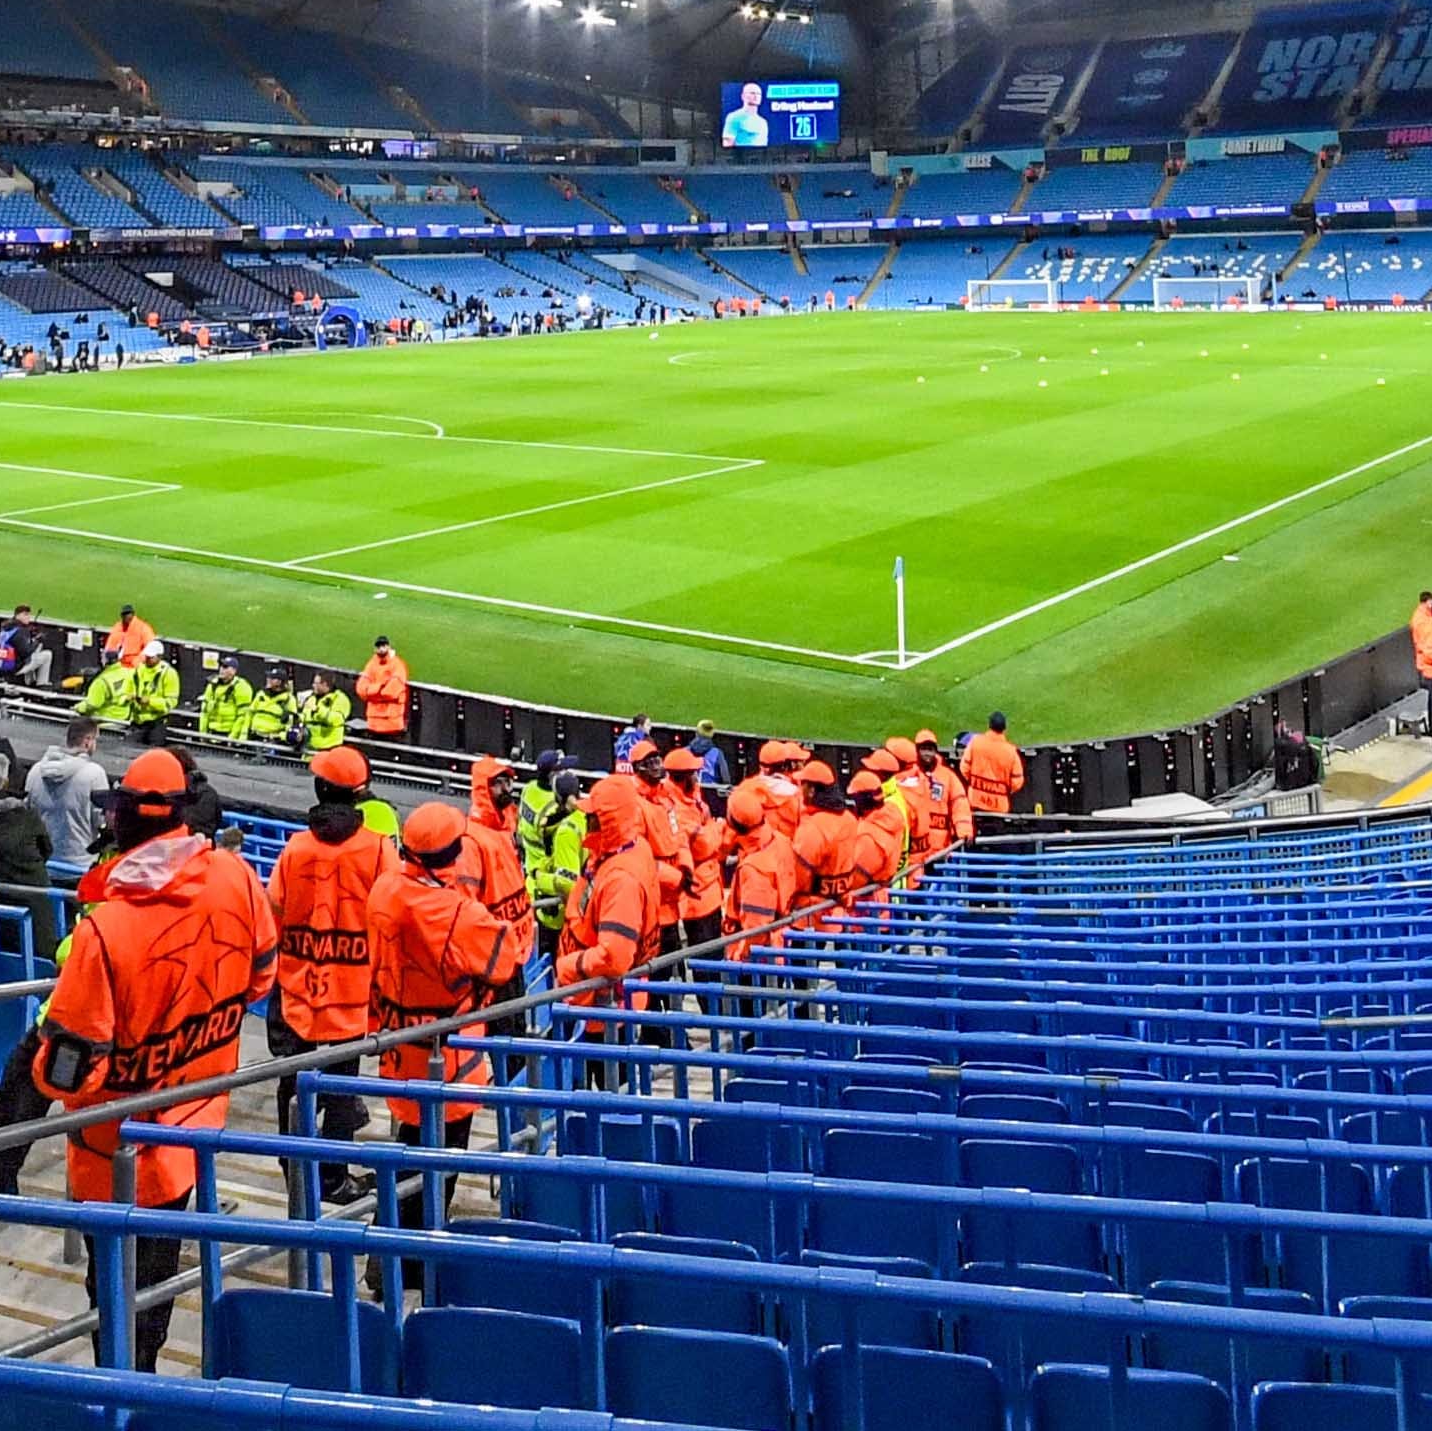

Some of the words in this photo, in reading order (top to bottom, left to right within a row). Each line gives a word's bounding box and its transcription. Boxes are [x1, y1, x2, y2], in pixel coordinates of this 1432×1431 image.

[795, 117, 812, 137] 26
[281, 929, 367, 960] STEWARD
[114, 1003, 243, 1083] STEWARD
